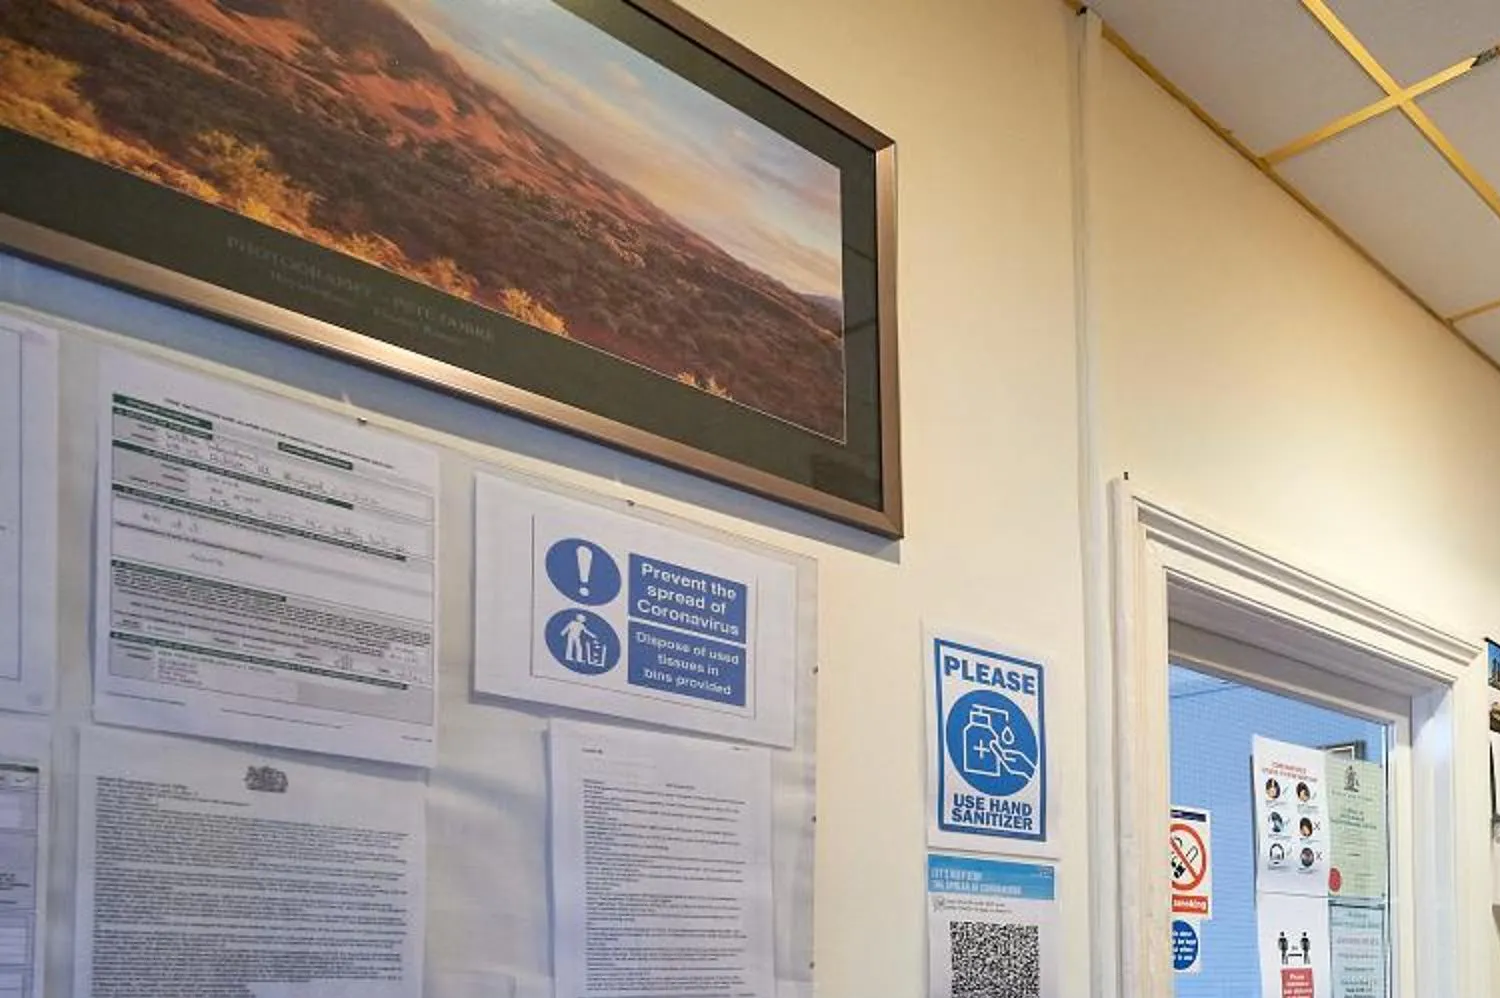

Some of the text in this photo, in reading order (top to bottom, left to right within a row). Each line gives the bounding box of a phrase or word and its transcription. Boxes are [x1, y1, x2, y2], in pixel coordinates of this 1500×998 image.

[640, 562, 737, 600] Prevent the
[647, 584, 728, 615] spread of
[637, 599, 740, 636] Coronavirus
[636, 630, 739, 665] Dispose of used
[657, 653, 719, 676] tissues in
[944, 654, 1036, 696] PLEASE
[643, 667, 732, 696] bins provided
[951, 807, 1033, 831] SANITIZER
[953, 793, 1033, 816] USE HAND
